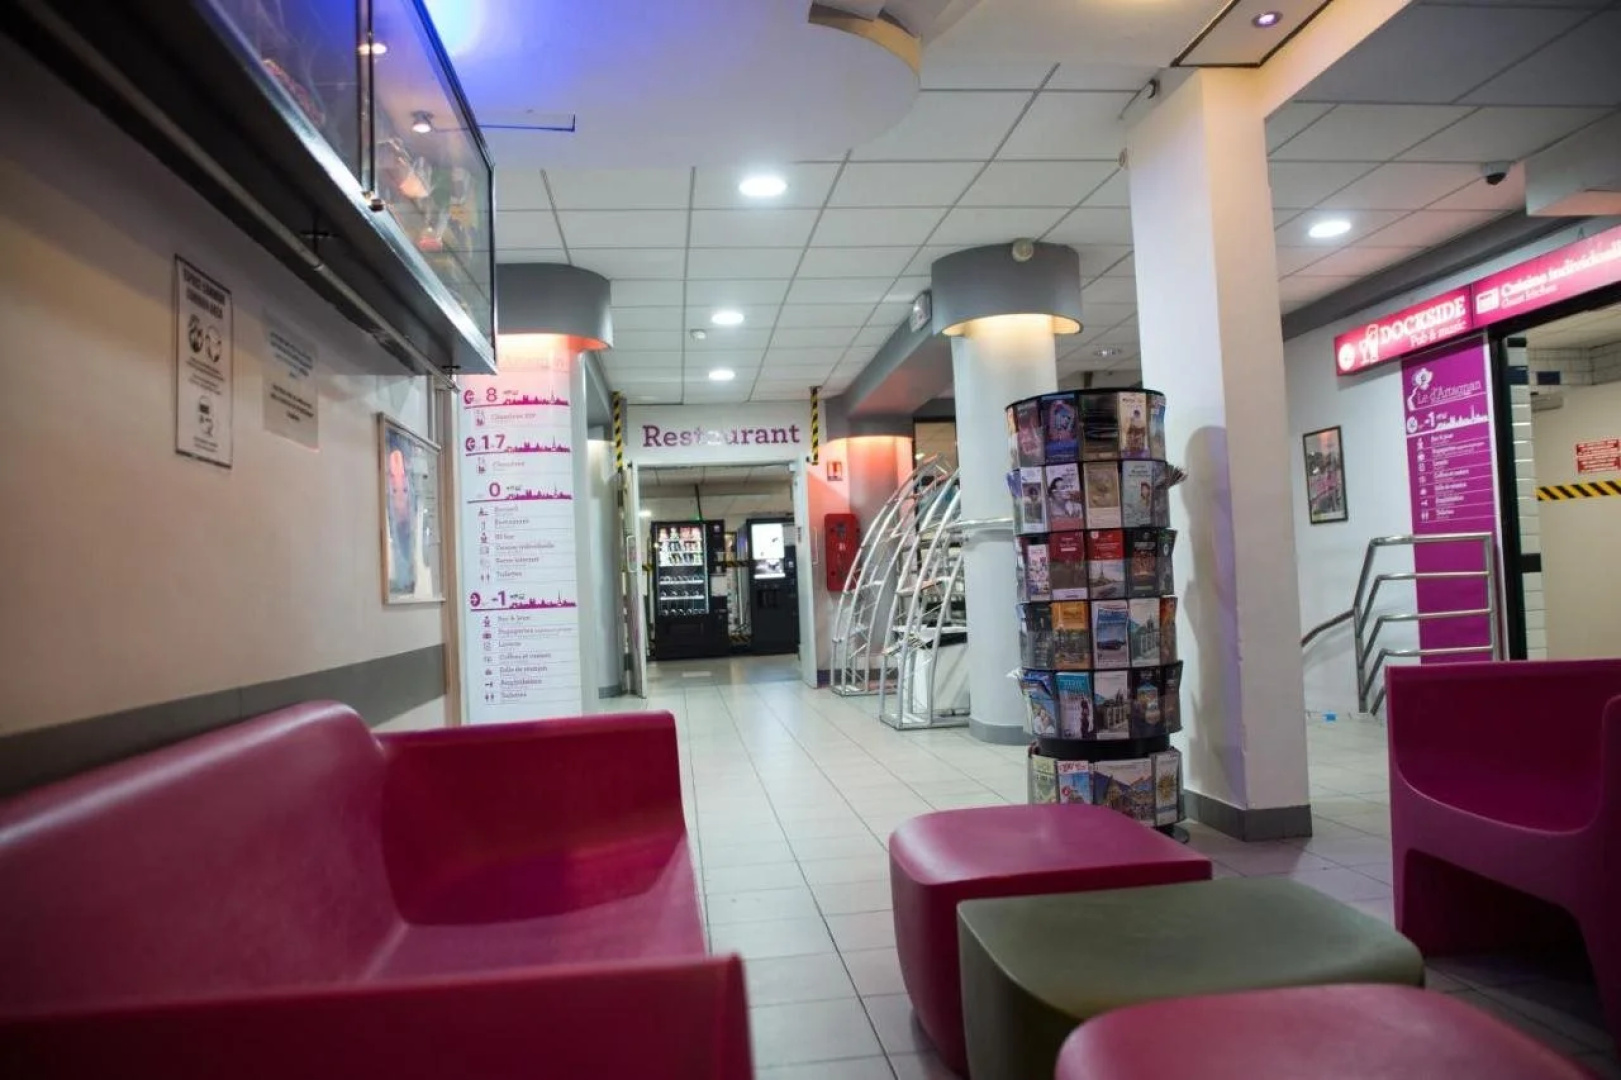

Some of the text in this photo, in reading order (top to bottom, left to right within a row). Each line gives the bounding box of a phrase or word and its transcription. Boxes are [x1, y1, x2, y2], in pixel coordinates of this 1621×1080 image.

[1380, 295, 1466, 344] DOCKSIDE
[1410, 332, 1427, 347] Pub
[486, 387, 497, 402] 8
[642, 424, 800, 447] Restaurant
[489, 482, 501, 497] 0
[491, 591, 506, 606] -1
